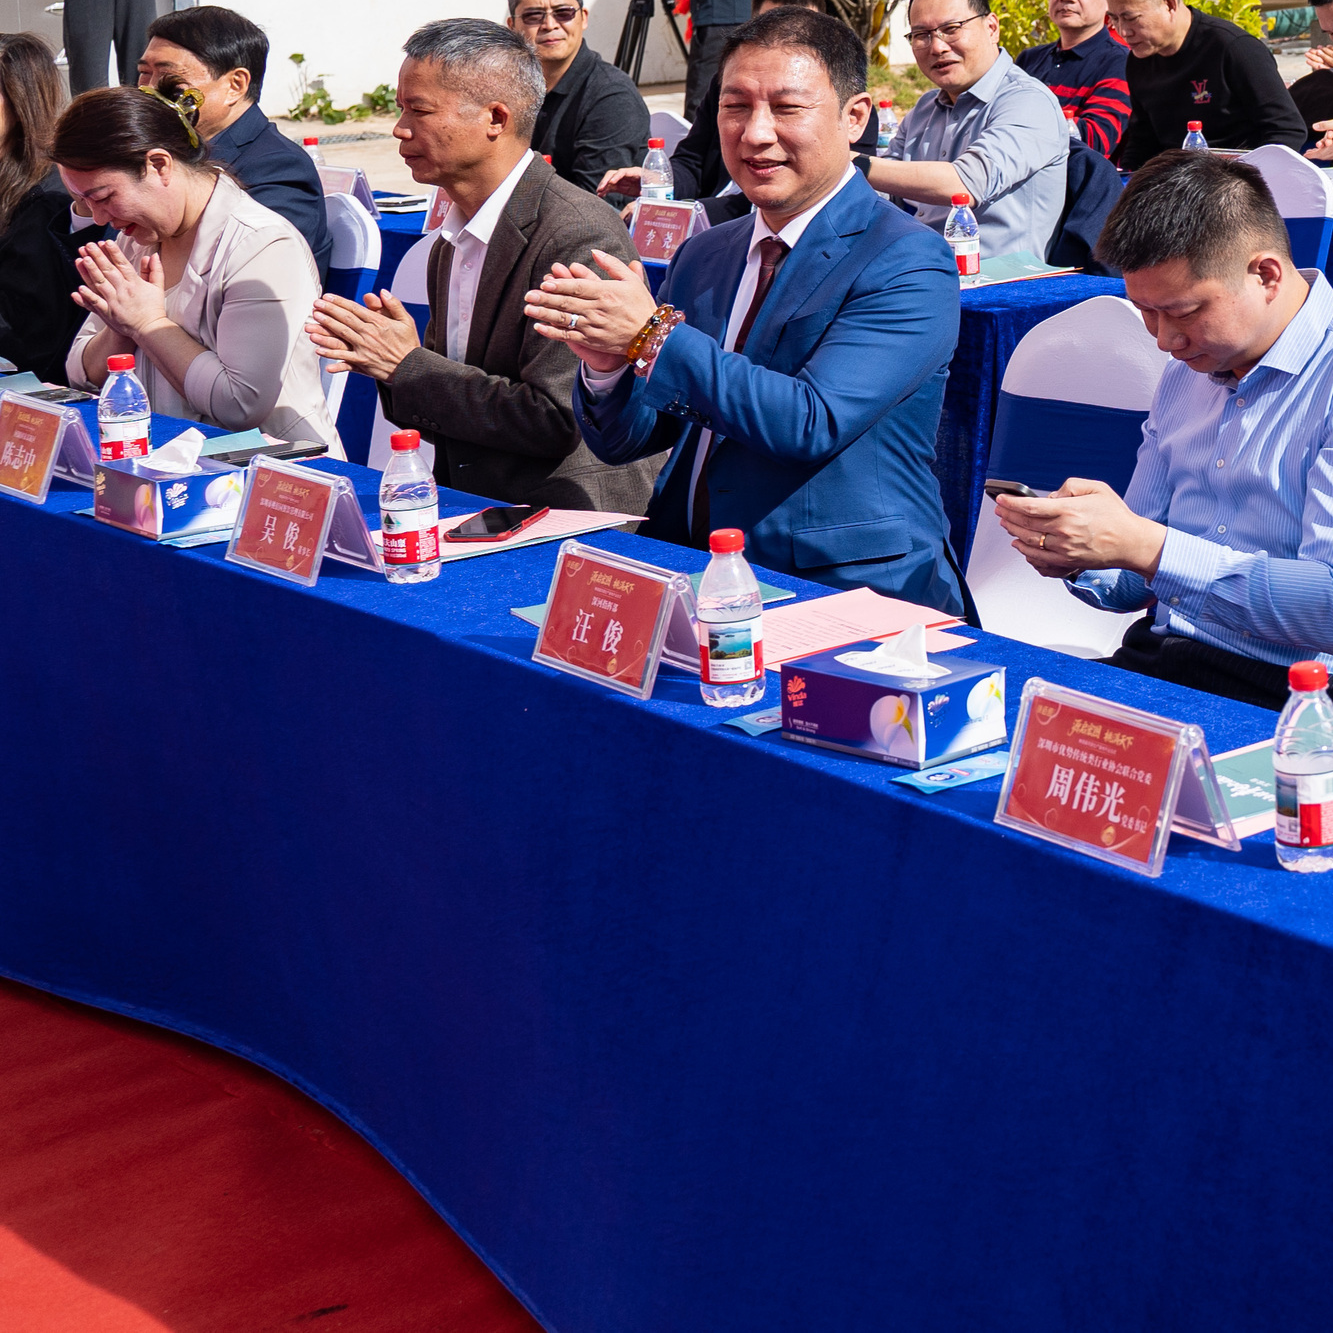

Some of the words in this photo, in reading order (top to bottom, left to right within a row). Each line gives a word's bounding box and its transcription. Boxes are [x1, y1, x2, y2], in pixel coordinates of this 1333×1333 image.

[259, 514, 300, 552] 吴俊
[383, 537, 407, 548] 夫山泉
[572, 608, 624, 655] 汪俊
[787, 692, 807, 703] Vinda
[1045, 764, 1126, 823] 周伟光
